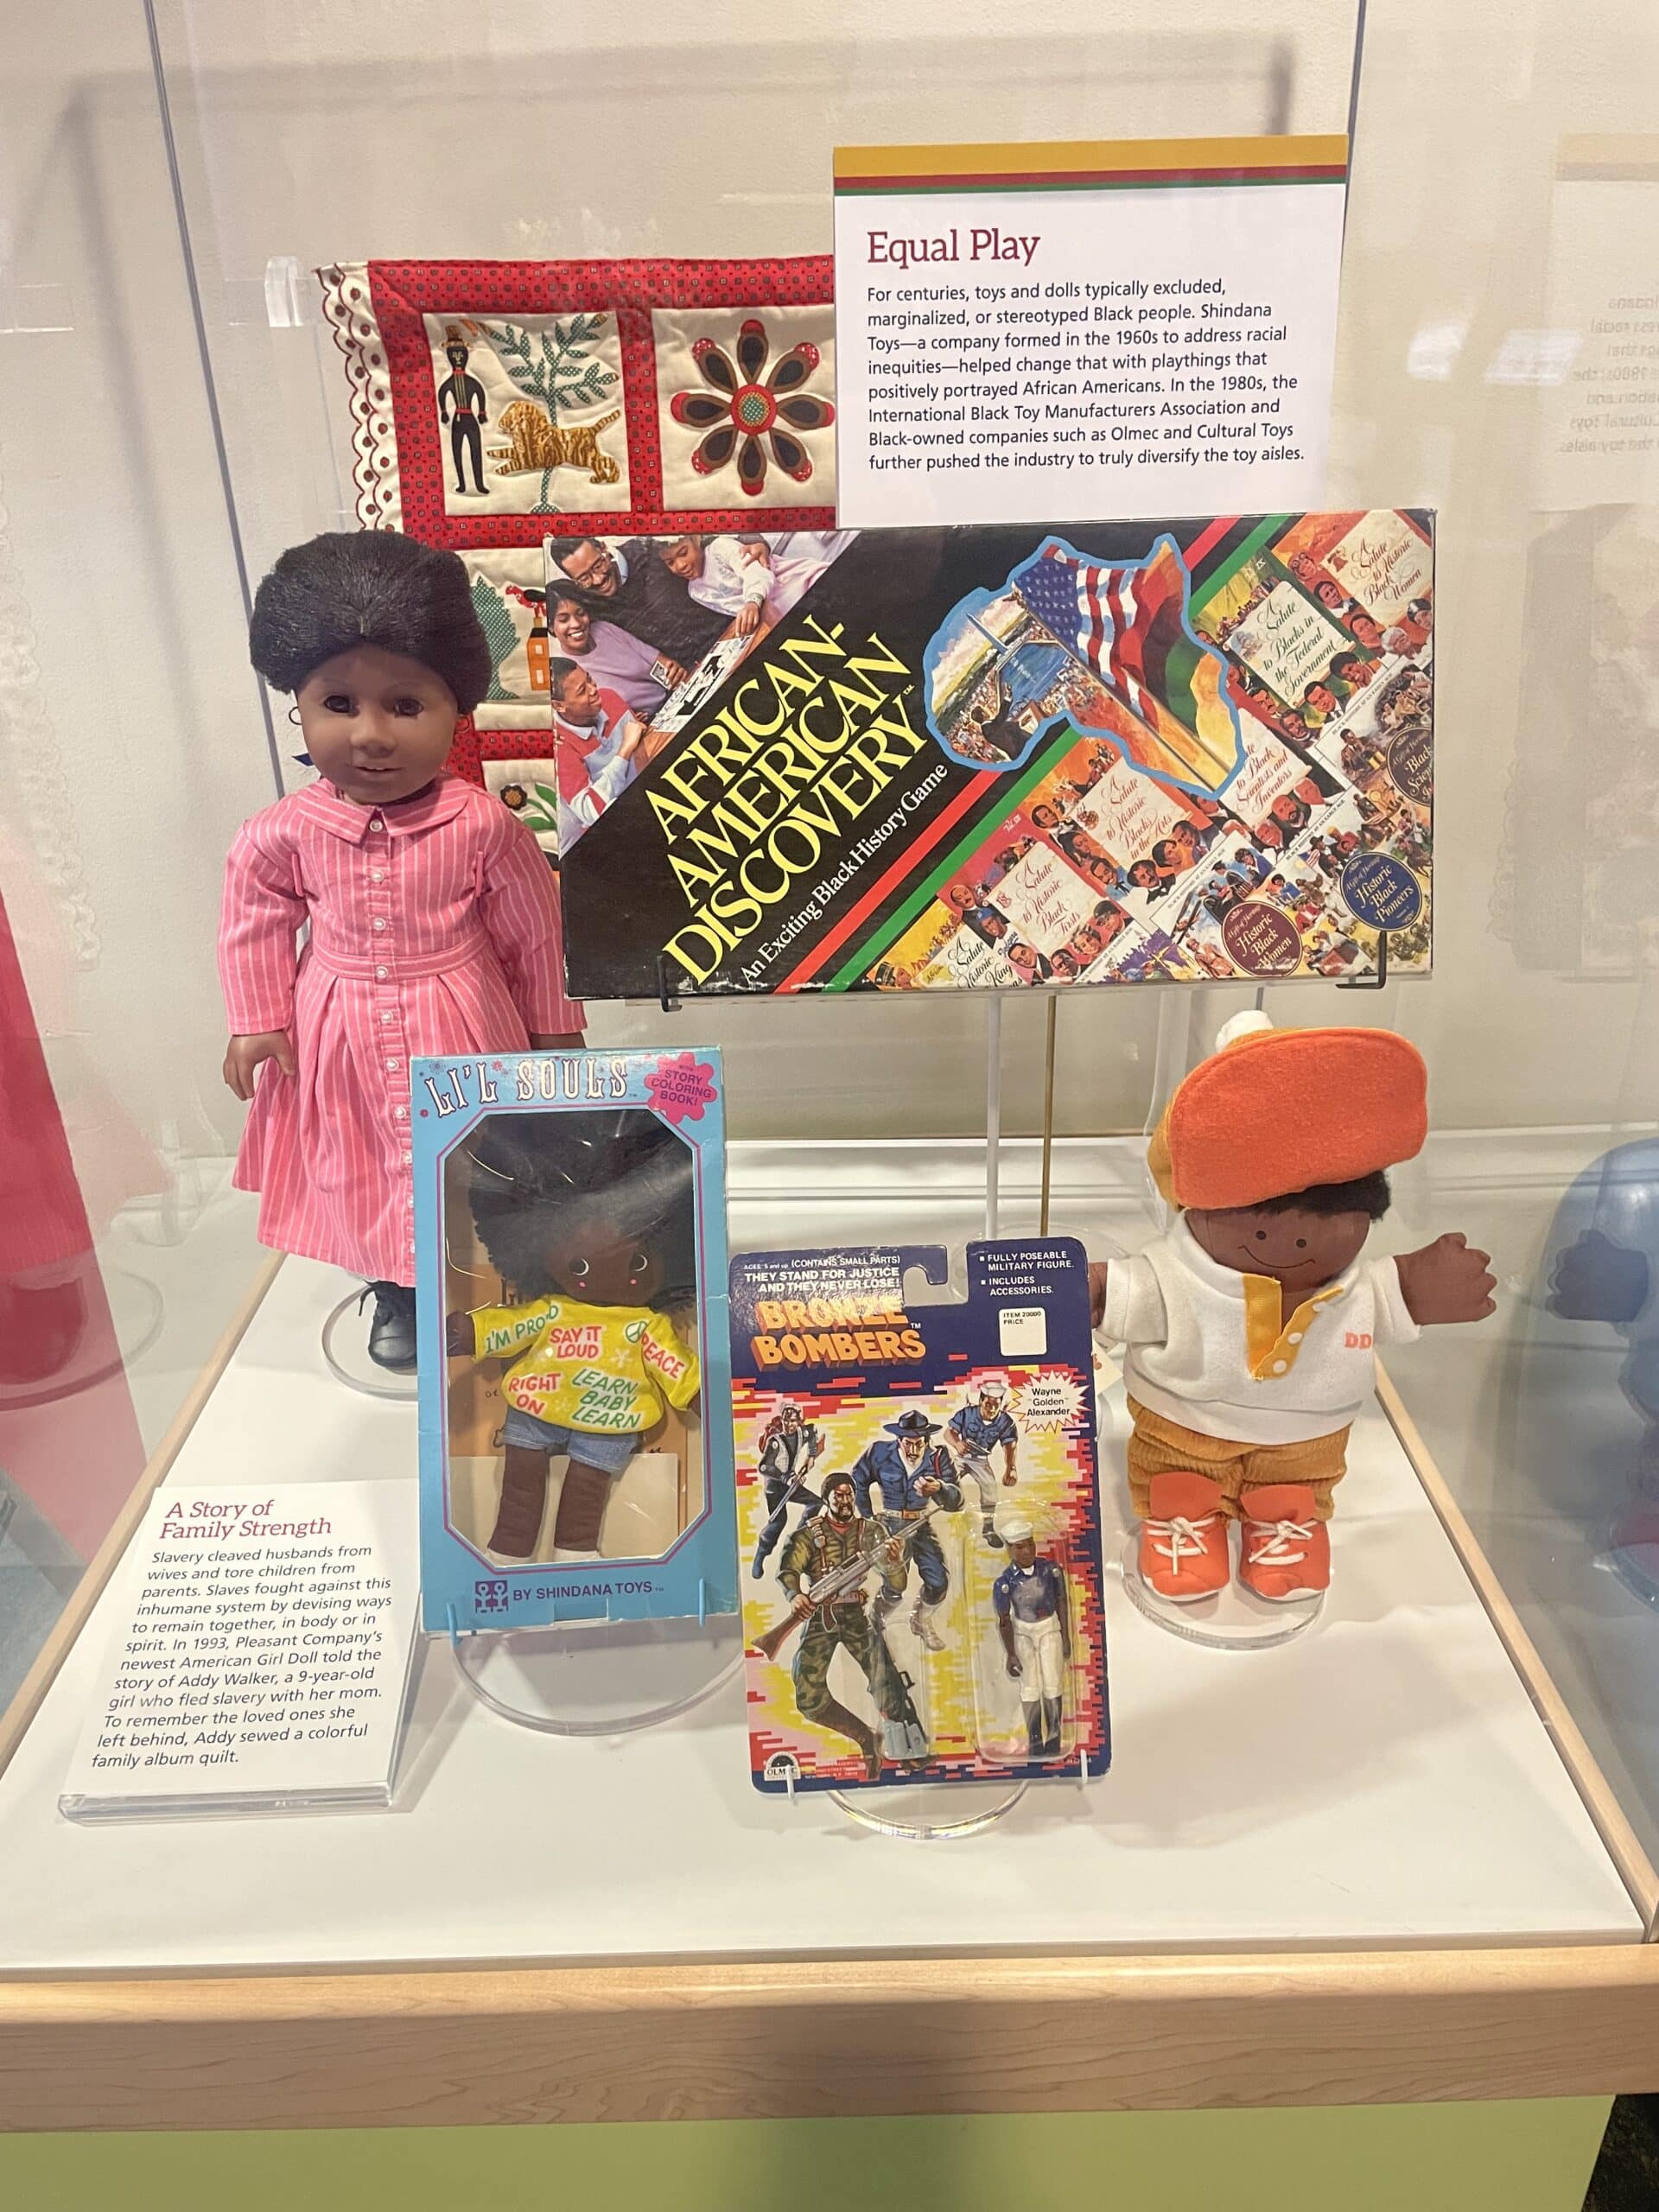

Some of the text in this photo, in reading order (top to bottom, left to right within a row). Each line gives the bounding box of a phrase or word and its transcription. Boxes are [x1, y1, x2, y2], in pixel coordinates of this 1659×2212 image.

[867, 227, 1041, 270] Equal Play
[868, 277, 1225, 303] For centuries, toys and dolls typically excluded,
[868, 302, 1272, 330] marginalized, or stereotyped Black people. Shindana
[868, 374, 1298, 403] positively portrayed African Americans. In the 1980s, the
[868, 445, 1304, 472] further pushed the industry to truly diversify the toy aisles.
[1363, 575, 1395, 606] Black
[1383, 566, 1422, 601] Women
[1261, 601, 1296, 636] Salute
[1270, 620, 1305, 663] Blacks
[1304, 614, 1314, 629] in
[1274, 626, 1324, 683] the Federal
[1284, 639, 1336, 696] Government
[645, 614, 846, 844] AFRICAN-
[667, 632, 912, 908] AMERICAN
[1247, 747, 1274, 779] Black
[1273, 749, 1288, 772] and
[663, 694, 927, 985] DISCOVERY
[741, 764, 948, 983] An Exciting Black History Game
[1355, 865, 1392, 908] Historic
[1370, 880, 1397, 907] Black
[1375, 886, 1414, 922] Pioneers
[1037, 900, 1069, 934] Black
[1236, 913, 1272, 957] Historic
[1251, 928, 1278, 956] Black
[1255, 937, 1292, 969] Women
[517, 1057, 628, 1101] SOULS
[652, 1077, 712, 1098] COLORING
[664, 1070, 703, 1085] STORY
[660, 1090, 697, 1106] BOOK!
[791, 1255, 900, 1268] (CONTAINS SMALL PARTS)
[988, 1250, 1067, 1262] FULLY POSEABLE
[988, 1262, 1034, 1272] MILITARY
[744, 1267, 899, 1283] THEY STAND FOR JUSTICE
[759, 1277, 899, 1293] AND THEY NEVER LOSE!
[989, 1276, 1035, 1286] INCLUDES
[756, 1297, 908, 1332] BRONZE
[486, 1305, 559, 1354] I'M PROD
[550, 1325, 602, 1344] SAY IT
[1344, 1331, 1372, 1350] DD
[556, 1344, 599, 1358] LOUD
[641, 1332, 684, 1379] PEACE
[753, 1329, 926, 1368] BOMBERS
[508, 1373, 561, 1393] RIGHT
[571, 1368, 639, 1395] LEARN
[1032, 1388, 1061, 1396] Wayne
[517, 1394, 545, 1415] ON
[580, 1390, 637, 1412] BABY
[1027, 1407, 1070, 1417] Alexander
[571, 1407, 642, 1428] LEARN
[165, 1499, 275, 1520] A Story of
[159, 1517, 331, 1541] Family Strength
[152, 1545, 372, 1565] Slavery cleaved husbands from
[513, 1580, 652, 1601] BY SHINDANA TOYS
[137, 1597, 391, 1616] inhumane system by devising ways
[125, 1639, 167, 1655] spirit.
[173, 1639, 187, 1650] In
[194, 1637, 229, 1650] 1993,
[236, 1635, 298, 1648] Pleasant
[120, 1649, 382, 1670] newest American Girl Doll told the
[98, 1723, 368, 1747] left behind, Addy sewed a colorful
[767, 1767, 796, 1777] OLMC
